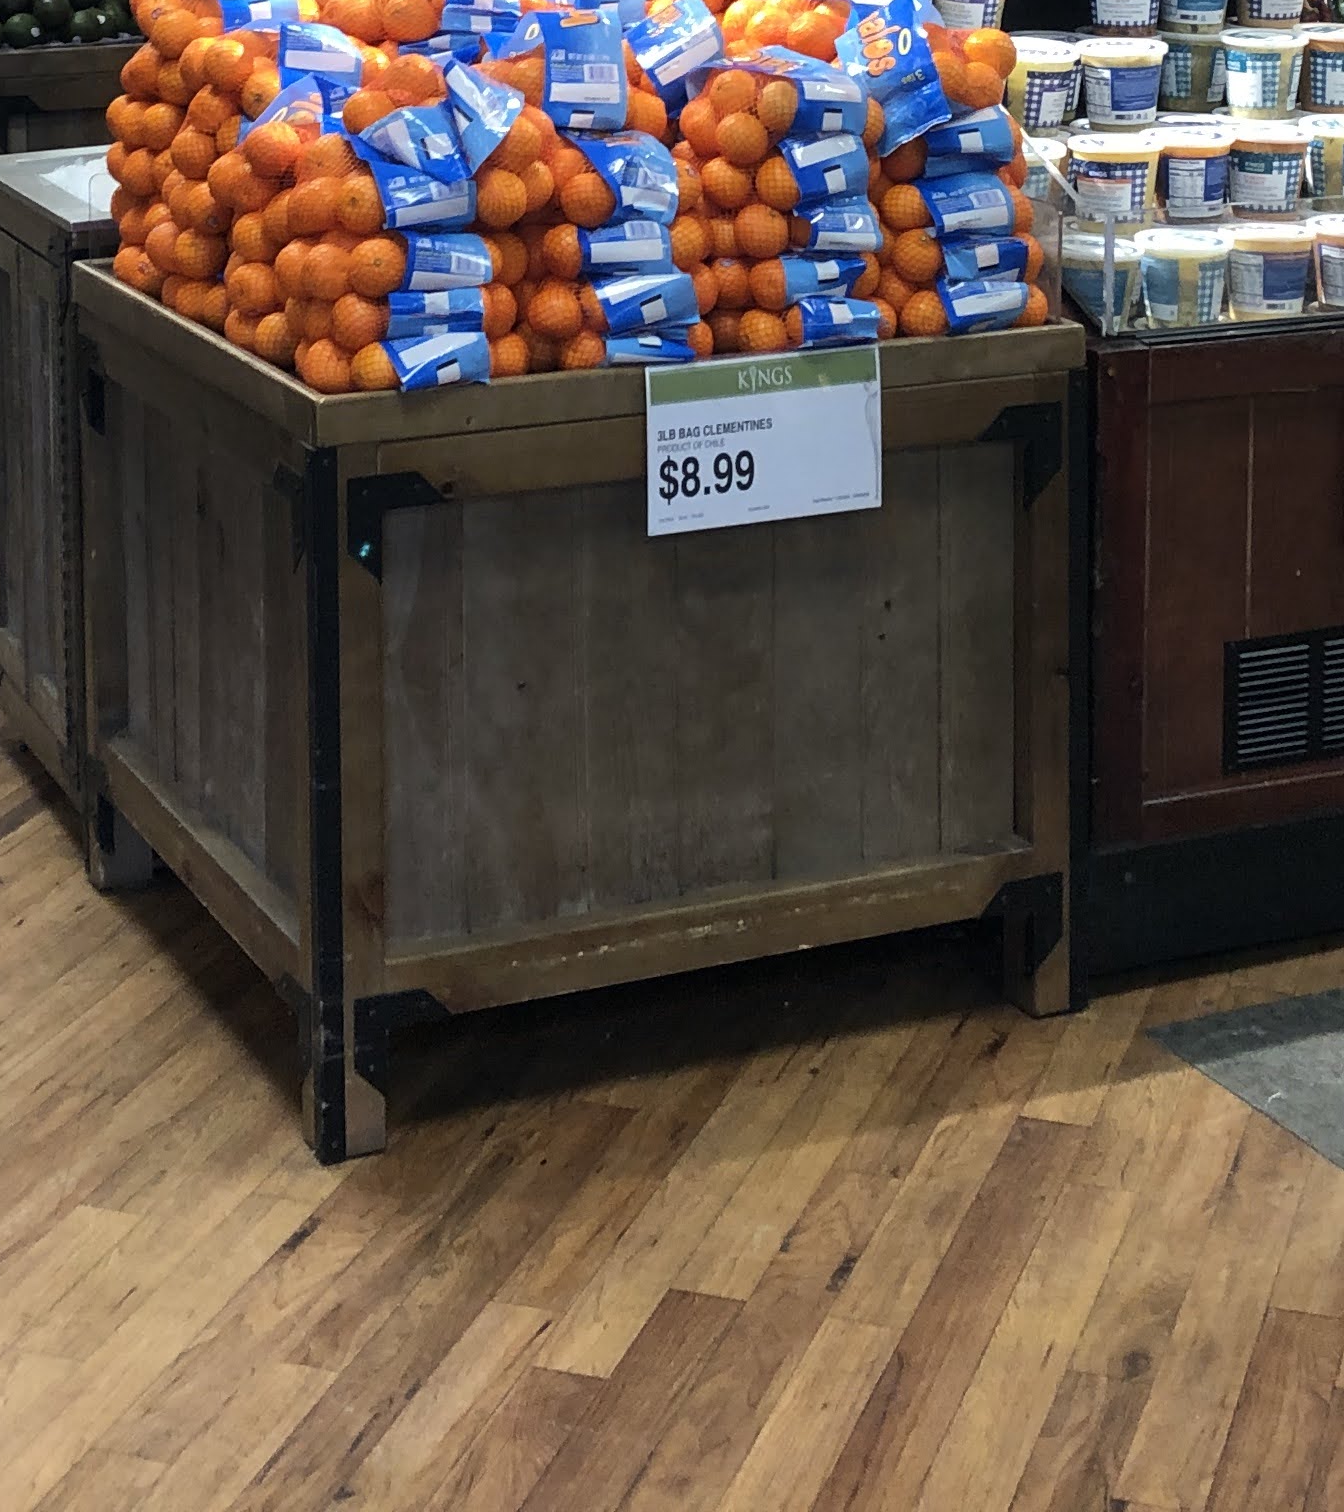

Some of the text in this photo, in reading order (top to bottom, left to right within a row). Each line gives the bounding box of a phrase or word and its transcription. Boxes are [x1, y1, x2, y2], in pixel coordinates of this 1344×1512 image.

[737, 365, 793, 393] KINGS
[657, 417, 773, 442] 3LB BAG CLEMENTINES
[693, 440, 703, 450] OF
[658, 449, 755, 505] $8.99
